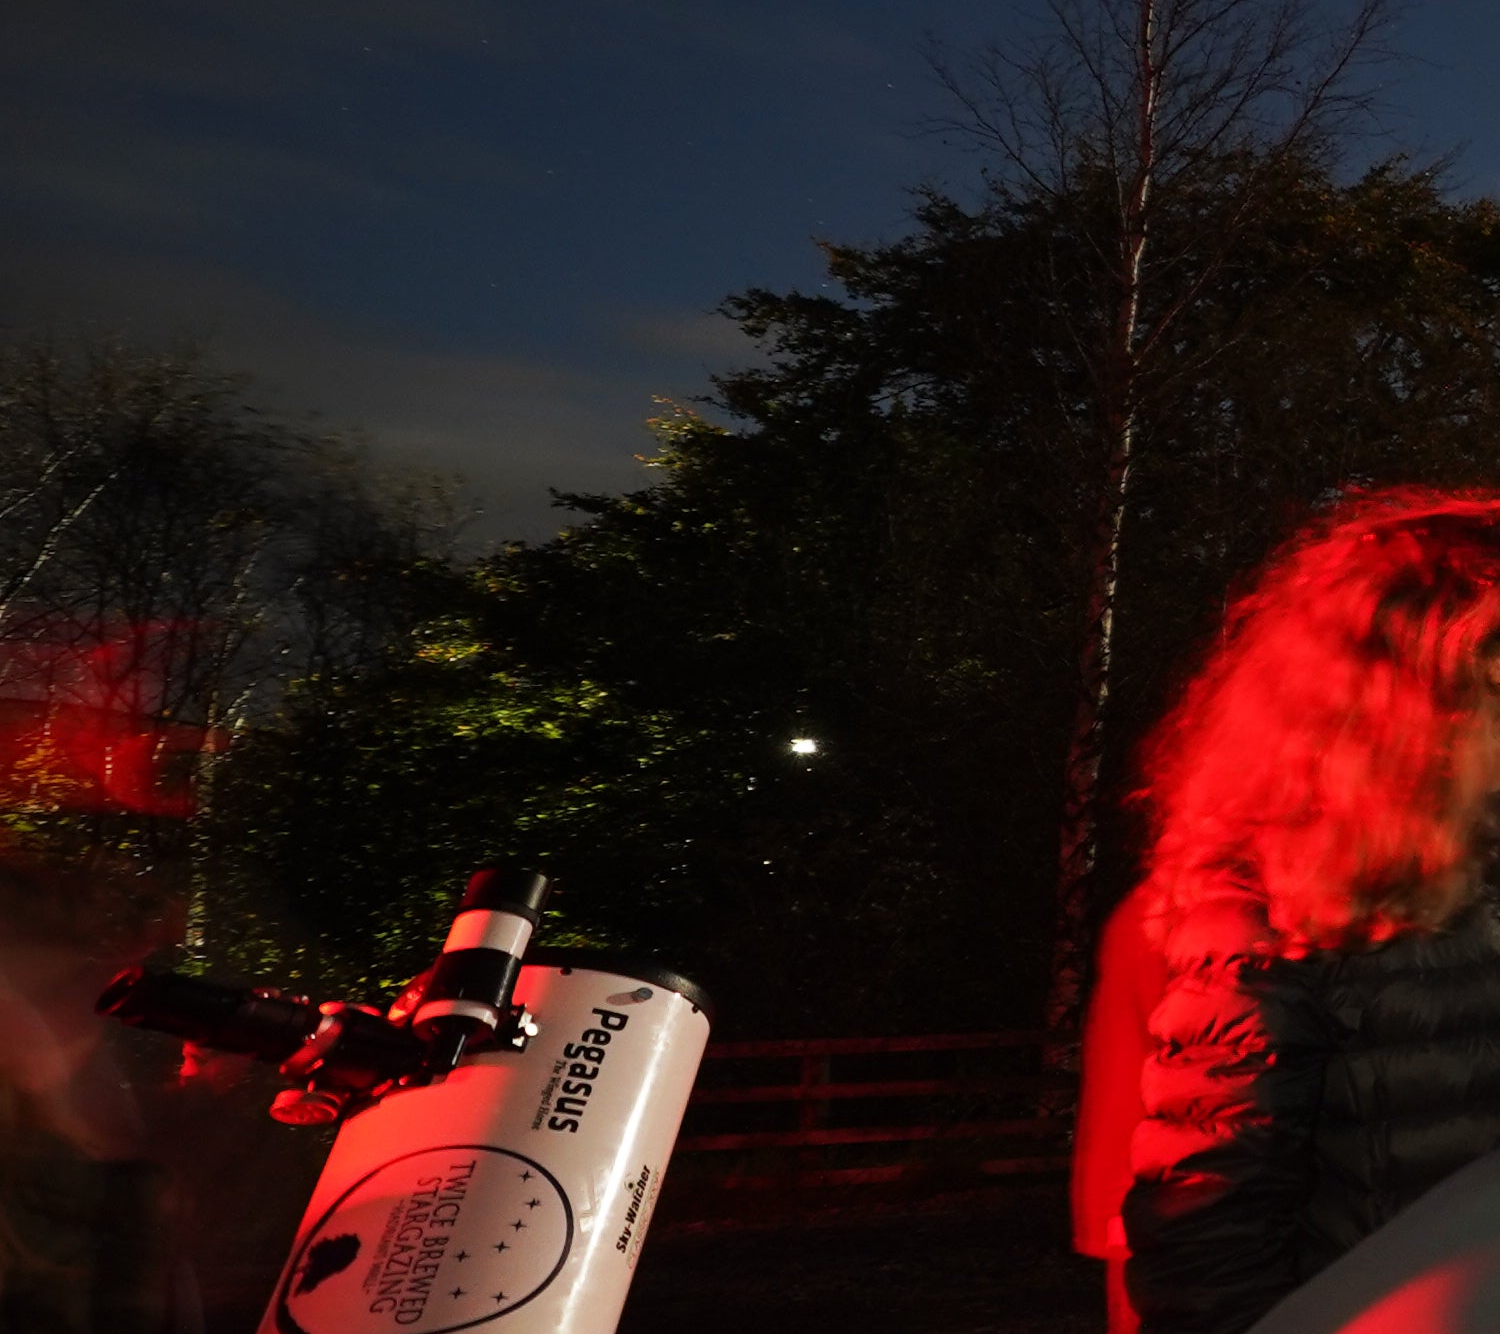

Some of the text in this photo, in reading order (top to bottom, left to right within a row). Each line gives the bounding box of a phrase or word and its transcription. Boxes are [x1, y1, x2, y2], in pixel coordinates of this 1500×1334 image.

[548, 1008, 629, 1133] Pegasus
[369, 1177, 442, 1314] STARGAZING
[395, 1160, 476, 1325] TWICE BREWED
[616, 1165, 650, 1254] Sky-Watcher
